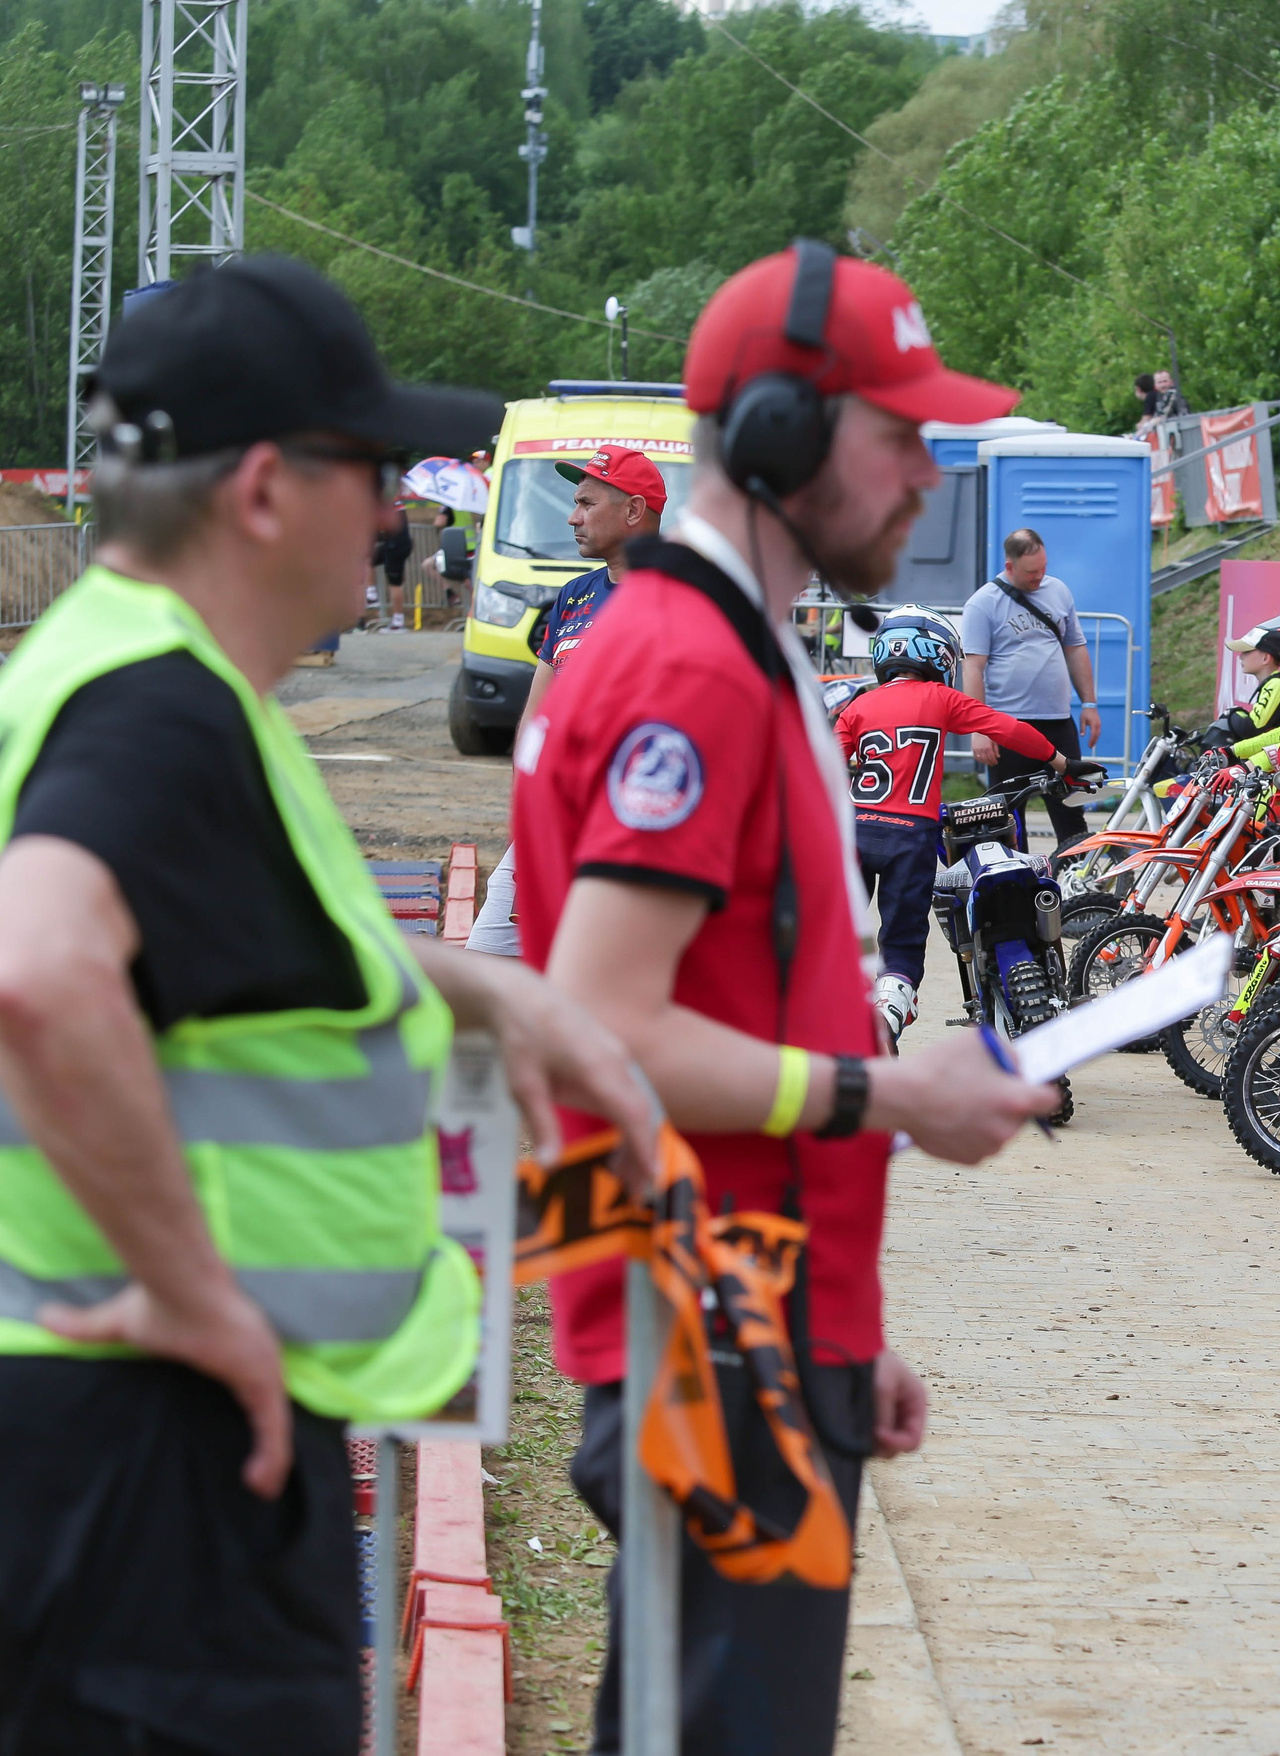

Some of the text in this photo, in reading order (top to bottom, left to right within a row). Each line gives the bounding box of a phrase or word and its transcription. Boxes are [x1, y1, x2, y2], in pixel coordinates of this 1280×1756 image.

[848, 725, 942, 805] 67
[953, 802, 1004, 818] RENTHAL
[955, 811, 1005, 825] RENTHAL
